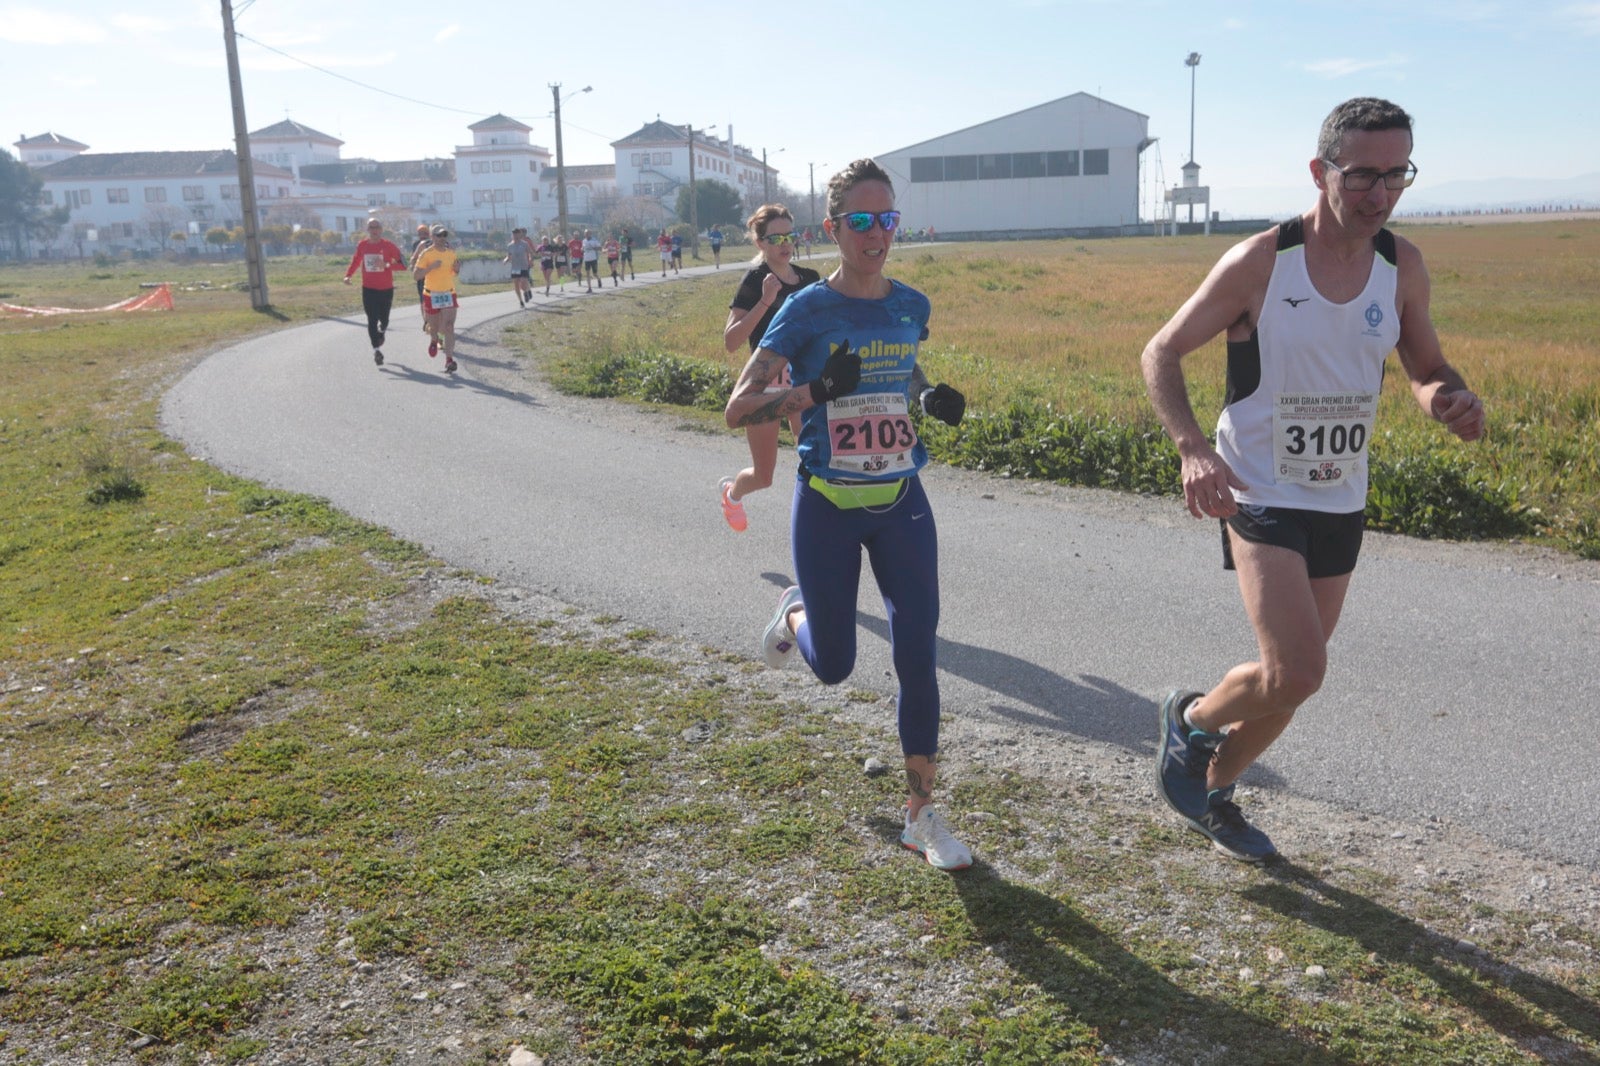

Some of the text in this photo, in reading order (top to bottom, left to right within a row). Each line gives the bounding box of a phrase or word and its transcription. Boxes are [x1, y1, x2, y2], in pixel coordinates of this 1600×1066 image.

[850, 398, 866, 407] GRAN
[1301, 396, 1319, 405] GRAN
[1321, 396, 1343, 404] PREMIO
[1345, 396, 1353, 404] DE
[835, 419, 913, 450] 2103
[1286, 424, 1365, 455] 3100
